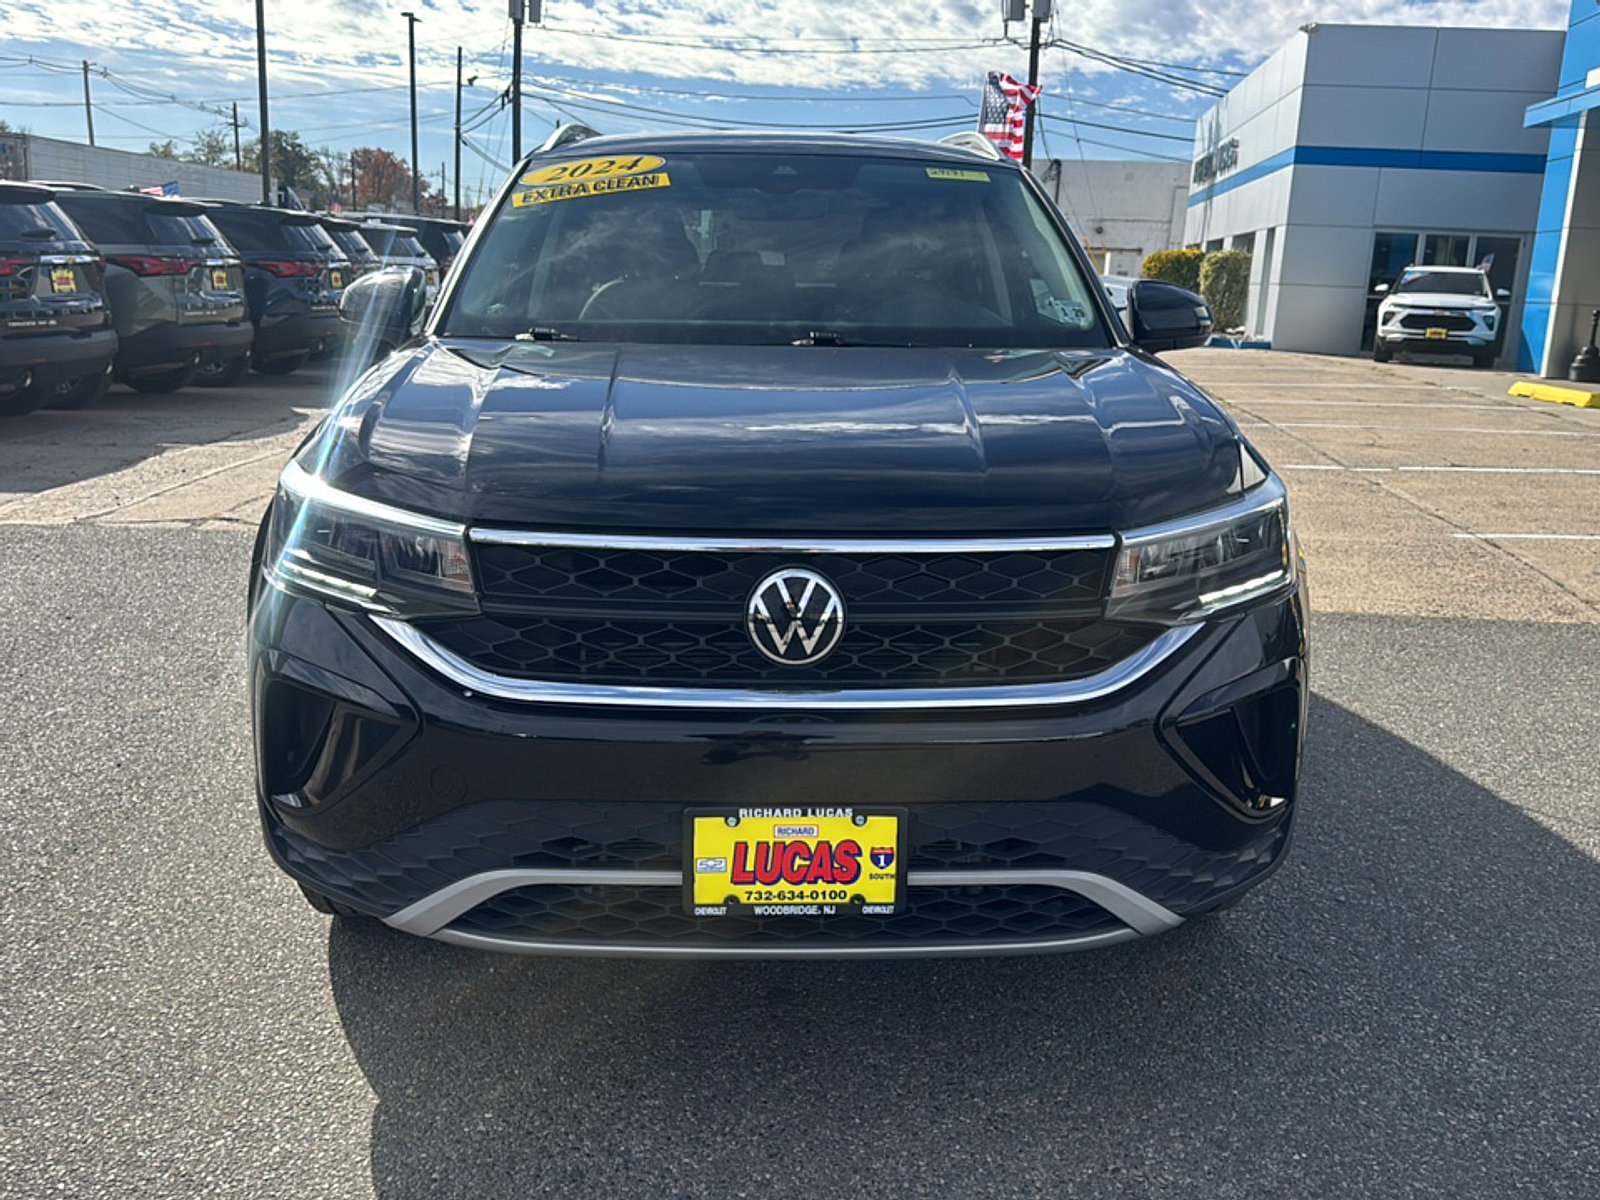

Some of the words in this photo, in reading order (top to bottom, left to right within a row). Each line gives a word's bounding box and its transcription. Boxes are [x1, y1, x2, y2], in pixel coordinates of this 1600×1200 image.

[545, 156, 643, 182] 2024
[521, 184, 590, 204] EXTRA
[594, 175, 660, 191] CLEAN
[740, 808, 802, 818] RICHARD
[807, 808, 853, 818] LUCAS
[777, 827, 814, 836] RICHARD
[731, 839, 863, 885] LUCAS
[878, 854, 886, 868] 1
[869, 873, 896, 881] SOUTH
[745, 890, 848, 901] 732-634-0100
[823, 905, 837, 915] NJ
